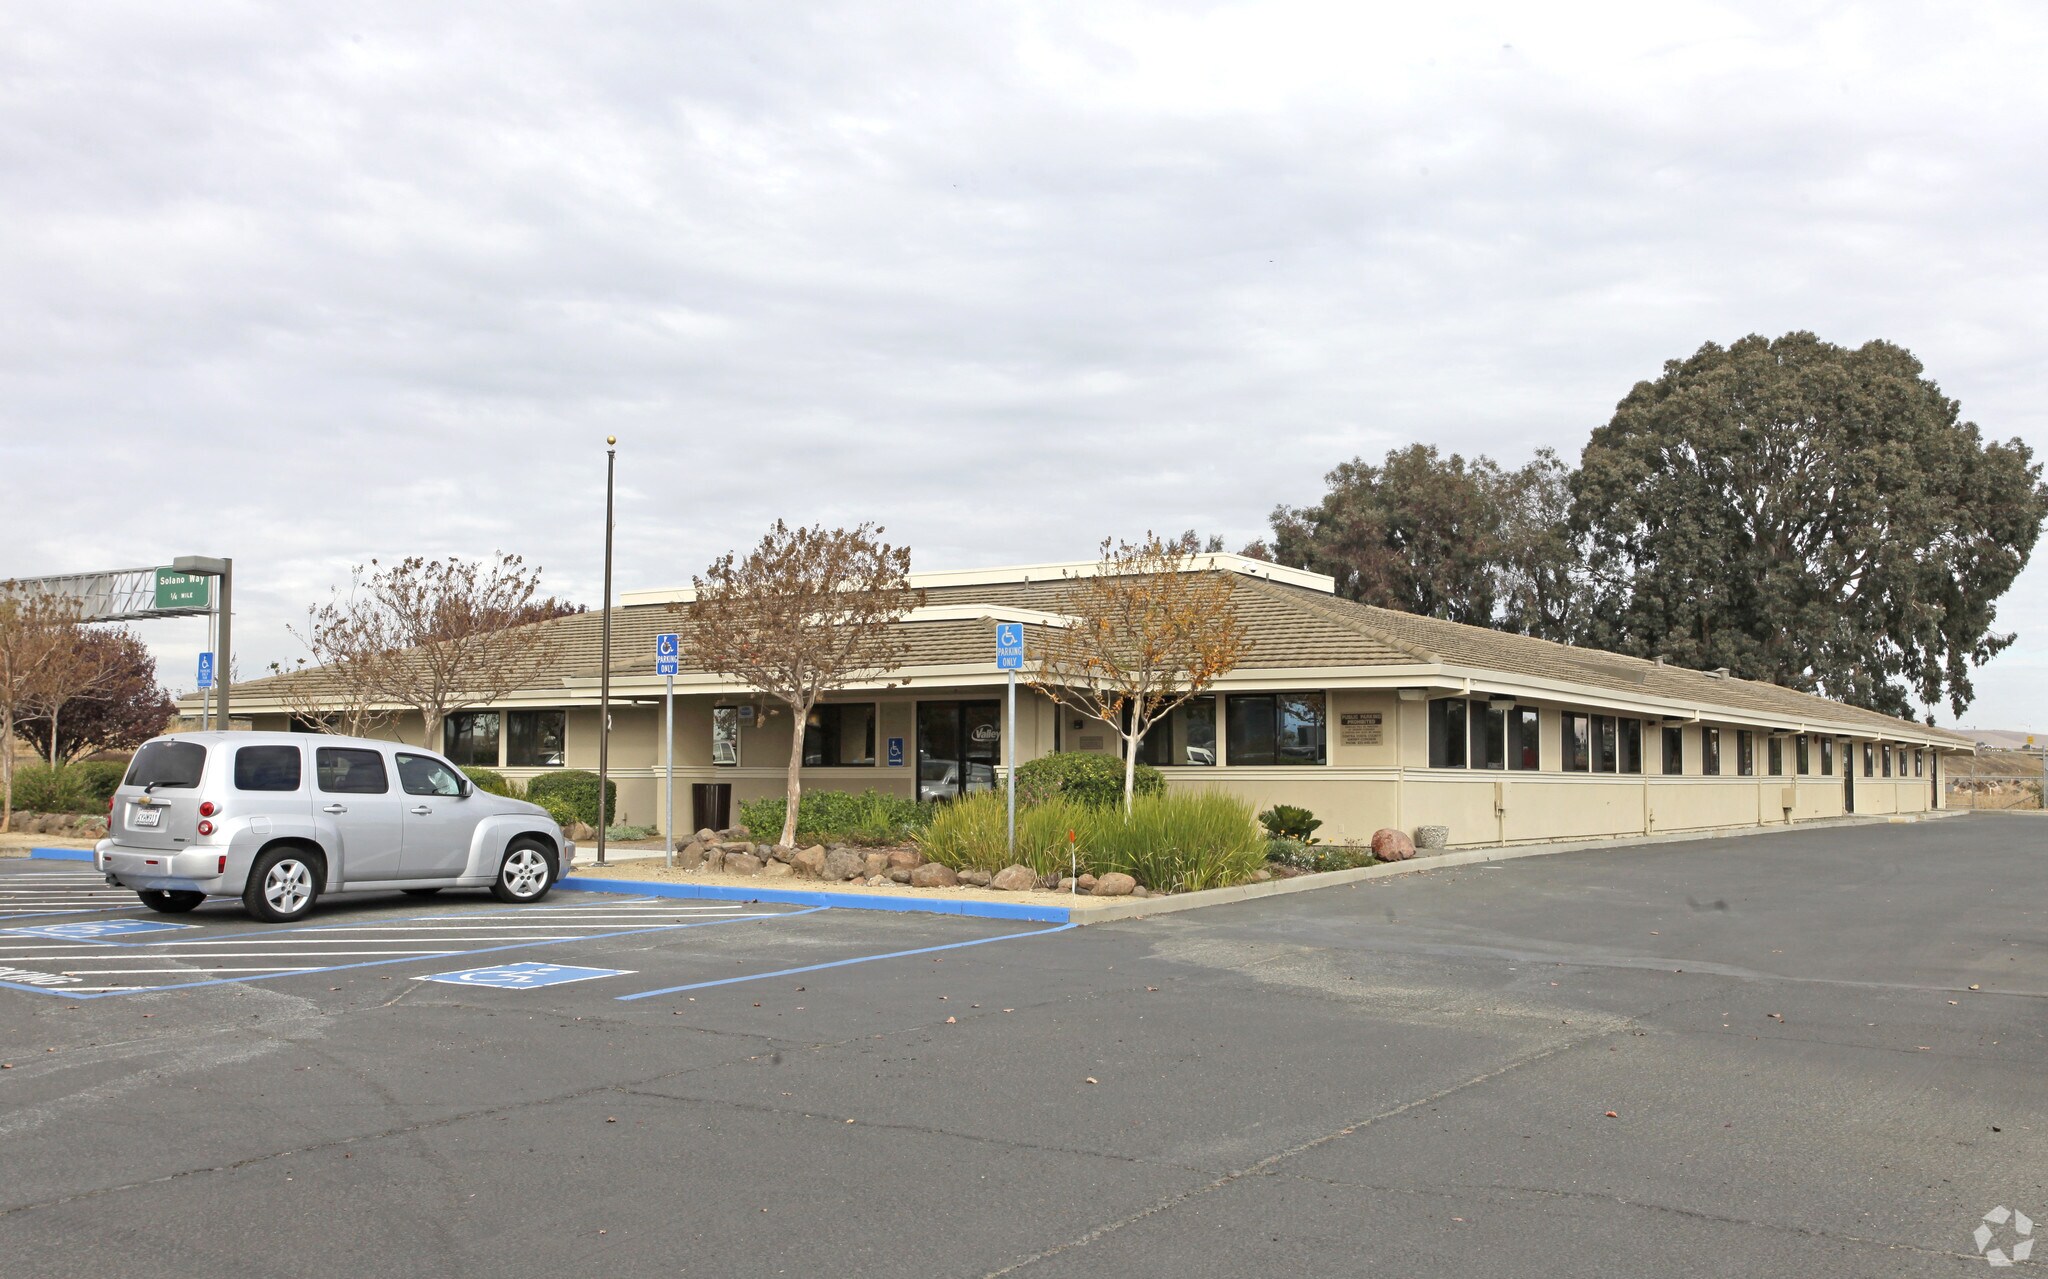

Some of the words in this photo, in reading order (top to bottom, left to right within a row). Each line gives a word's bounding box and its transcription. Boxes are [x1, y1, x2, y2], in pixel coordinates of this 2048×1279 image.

[160, 577, 185, 585] Solano
[189, 574, 205, 585] Way
[997, 647, 1021, 656] PARKING
[658, 655, 677, 663] PARKING
[1002, 657, 1017, 667] ONLY
[976, 728, 1001, 741] Valley
